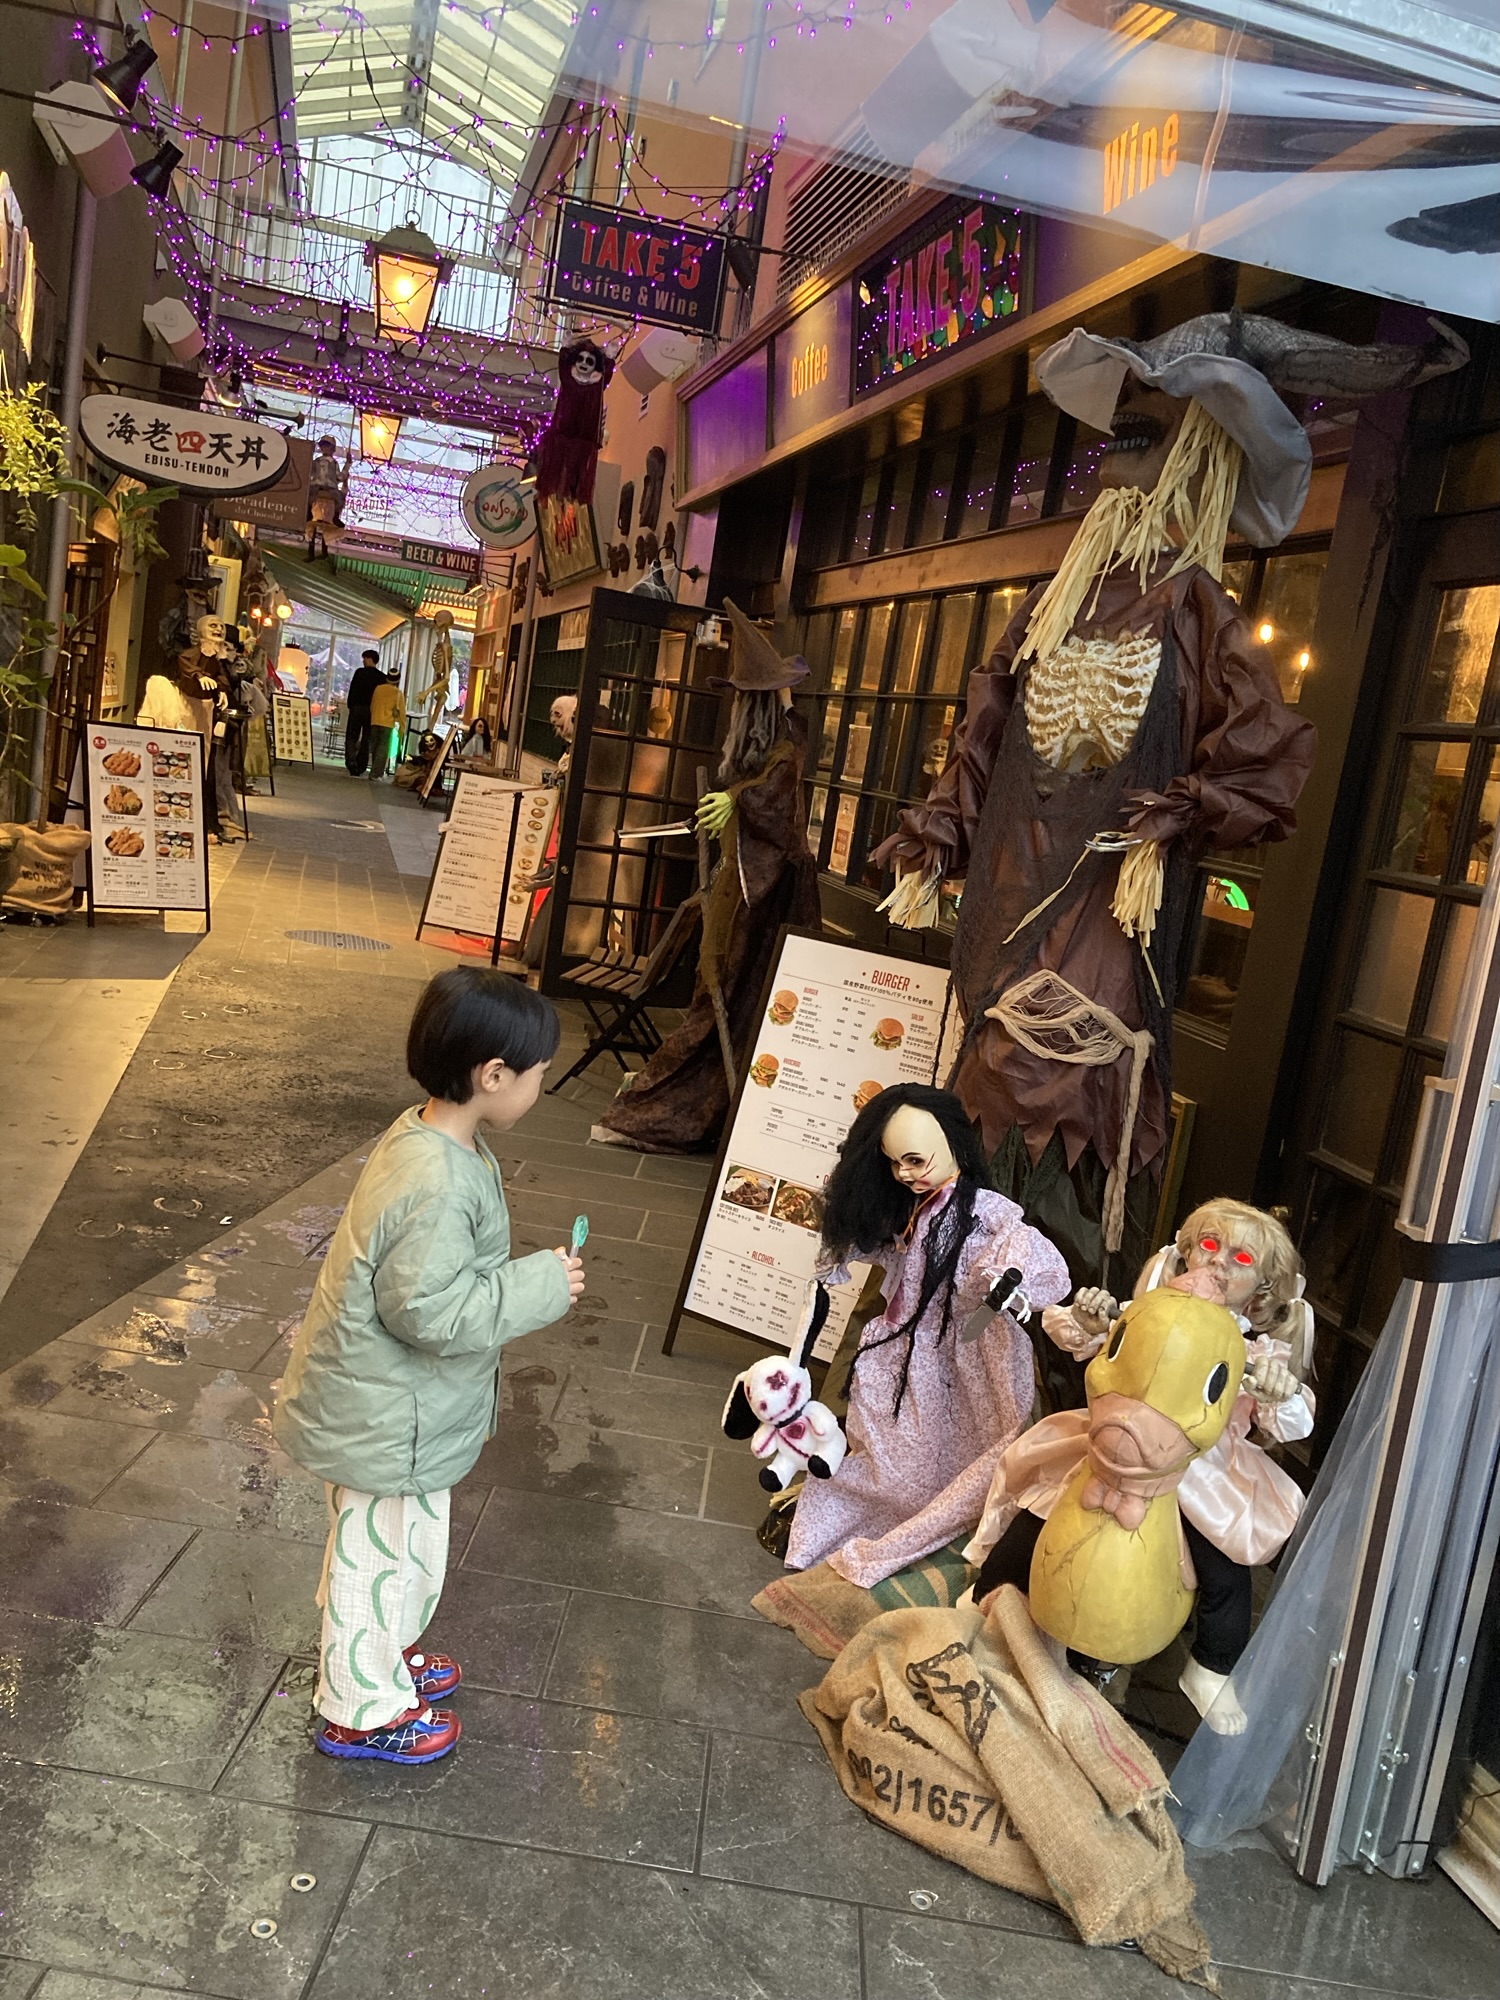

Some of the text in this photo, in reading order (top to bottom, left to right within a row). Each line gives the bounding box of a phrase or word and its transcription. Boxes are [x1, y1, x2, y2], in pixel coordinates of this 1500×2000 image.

[1103, 111, 1179, 215] Wine
[580, 221, 703, 290] TAKE 5
[571, 271, 699, 318] Coffee & Wine
[886, 205, 984, 359] TAKE 5
[791, 342, 829, 399] Coffee
[107, 412, 269, 471] 海老四天丼
[145, 453, 231, 478] EBISU-TENDON
[405, 541, 477, 573] BEER & WINE
[871, 970, 910, 992] BURGER
[752, 1250, 775, 1267] ALCOHOL
